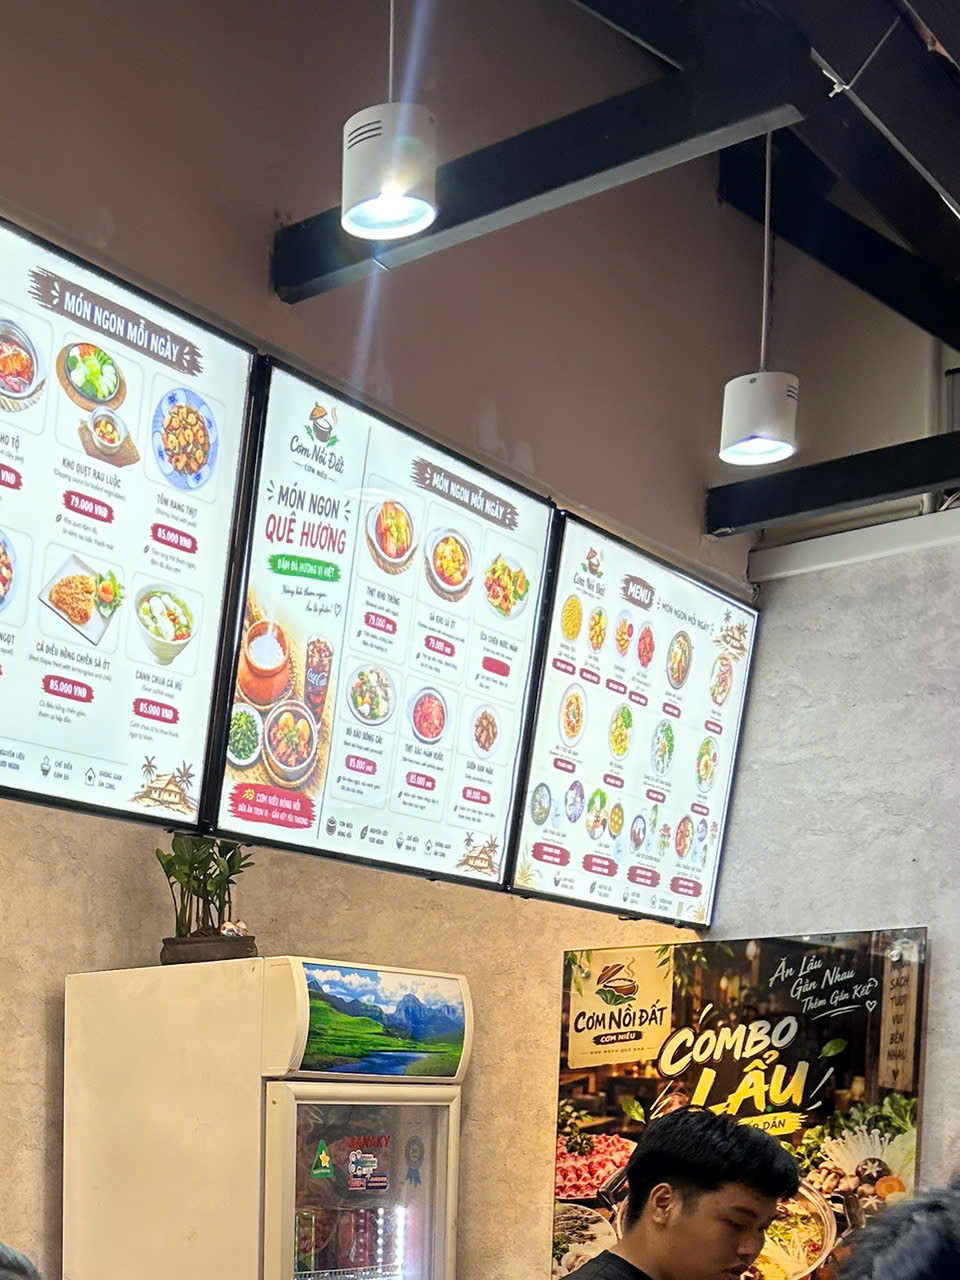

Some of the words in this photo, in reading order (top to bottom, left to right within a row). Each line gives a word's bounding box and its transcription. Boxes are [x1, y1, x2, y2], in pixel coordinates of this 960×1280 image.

[64, 291, 91, 321] MÓN
[93, 305, 125, 337] NGON
[150, 333, 179, 362] NGÀY
[278, 482, 305, 512] MÓN
[309, 493, 340, 519] NGON
[265, 513, 297, 544] QUÊ
[300, 523, 347, 555] HƯƠNG
[628, 581, 652, 604] MENU
[768, 956, 794, 987] Ăn
[798, 955, 823, 977] Lẩu
[790, 977, 818, 1000] Gần
[821, 969, 856, 989] Nhau
[574, 1011, 606, 1033] CƠM
[608, 1003, 637, 1030] NỒI
[638, 1000, 668, 1026] ĐẤT
[801, 995, 827, 1013] Thêm
[600, 1034, 617, 1043] CƠM
[618, 1032, 636, 1040] NIÊU
[657, 1015, 799, 1078] COMBO
[691, 1050, 809, 1117] LẨU
